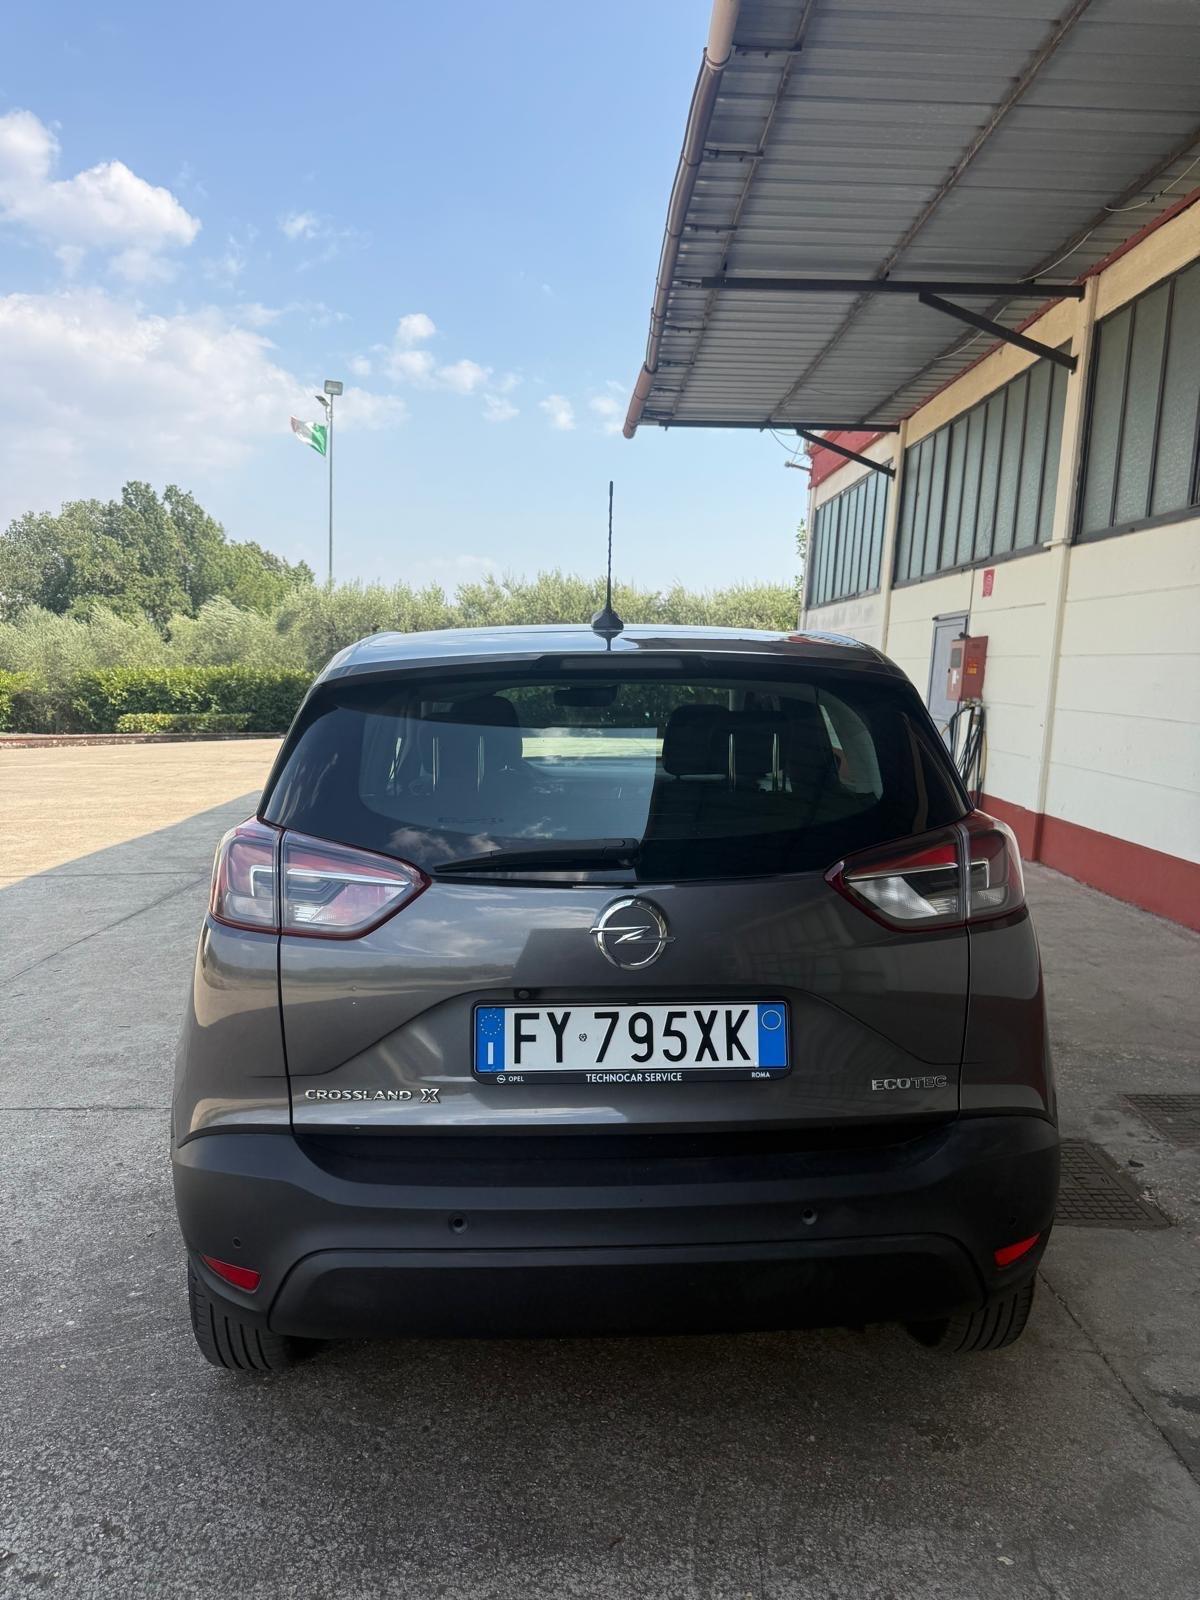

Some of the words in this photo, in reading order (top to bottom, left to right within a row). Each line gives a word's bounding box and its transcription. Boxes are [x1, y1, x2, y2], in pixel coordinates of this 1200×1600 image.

[514, 1011, 572, 1064] FY
[594, 1010, 752, 1063] 795XK
[585, 1073, 643, 1083] TECHNOCAR
[644, 1072, 683, 1082] SERVICE
[871, 1074, 948, 1091] ECOTEC
[304, 1088, 413, 1101] CROSSLAND
[419, 1088, 441, 1103] X
